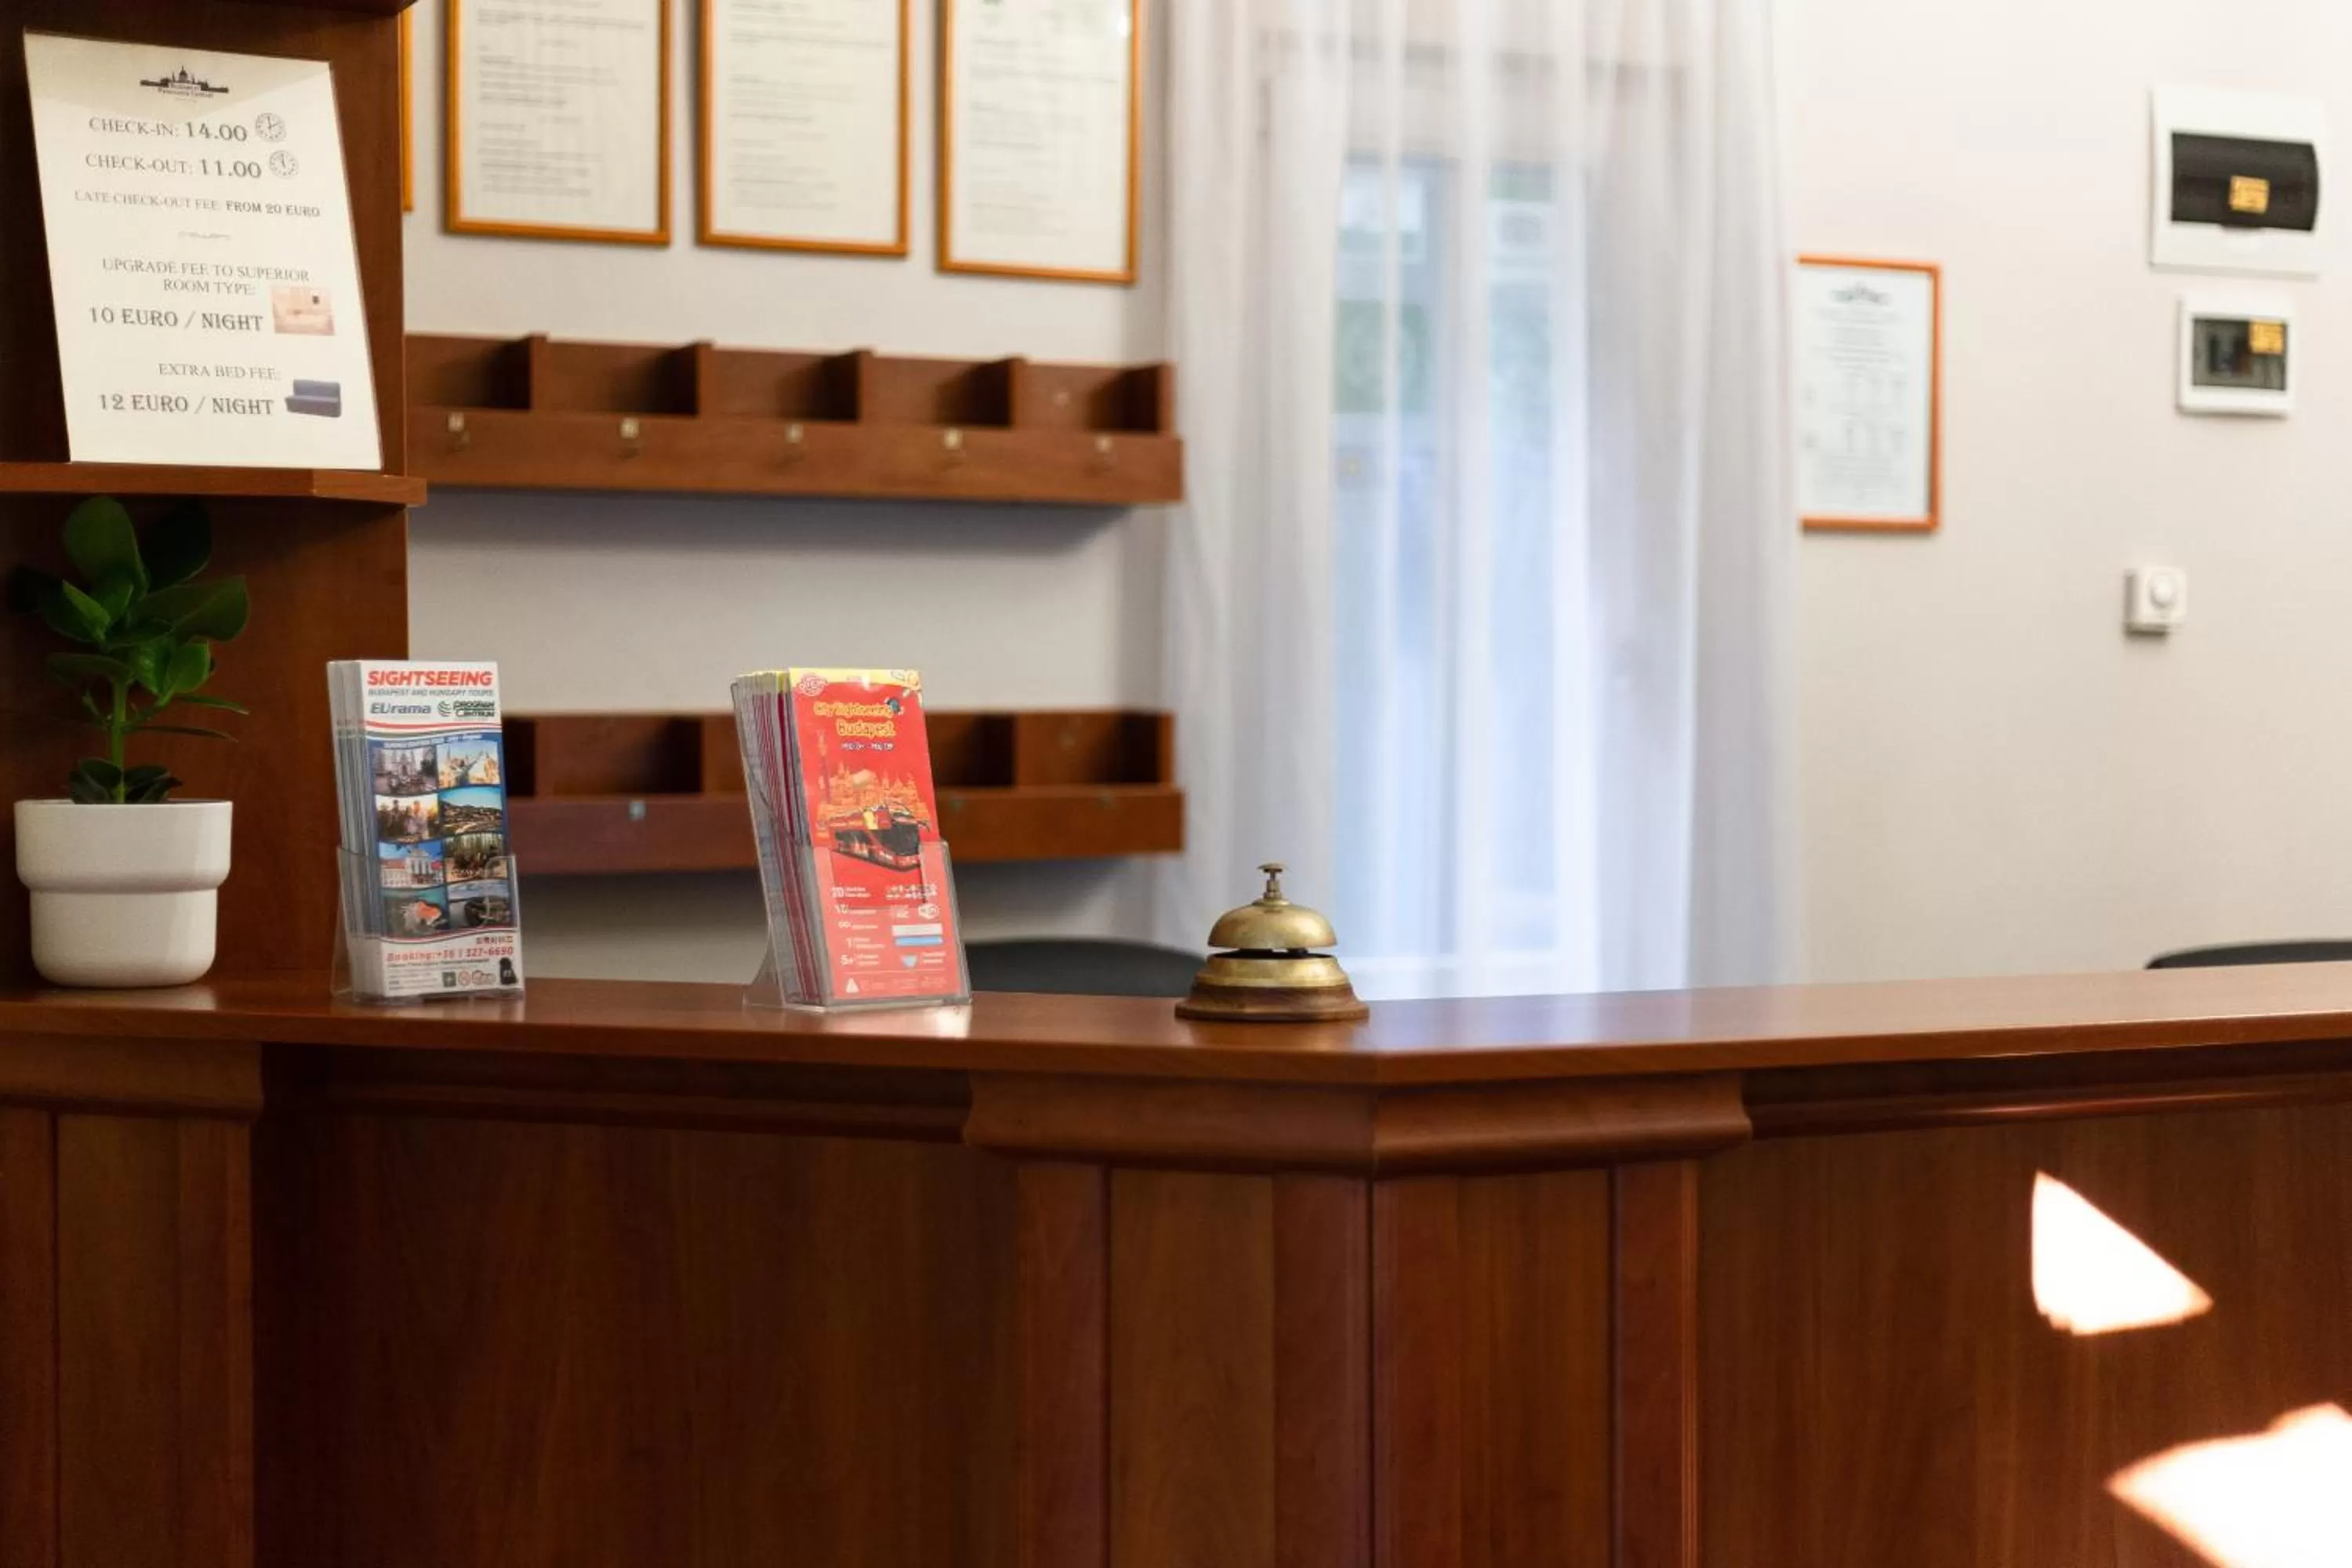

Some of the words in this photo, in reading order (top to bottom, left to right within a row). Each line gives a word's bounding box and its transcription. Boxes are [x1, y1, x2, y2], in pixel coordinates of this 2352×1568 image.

[89, 118, 179, 137] CHECK-IN:
[187, 122, 248, 142] 14.00
[85, 153, 194, 176] CHECK-OUT:
[201, 158, 262, 179] 11.00
[74, 191, 111, 203] LATE
[112, 194, 191, 209] CHECK-OUT
[226, 200, 262, 213] FROM
[265, 203, 282, 214] 20
[285, 205, 321, 217] EURO
[103, 257, 178, 274] UPGRADE
[181, 263, 209, 275] FEE
[212, 264, 234, 278] TO
[236, 266, 310, 281] SUPERIOR
[163, 278, 210, 293] ROOM
[212, 281, 256, 296] TYPE:
[90, 307, 115, 324] 10
[122, 308, 179, 328] EURO
[183, 310, 197, 329] /
[201, 313, 264, 332] NIGHT
[158, 362, 211, 377] EXTRA
[215, 364, 246, 378] BED
[249, 366, 281, 381] FEE:
[99, 394, 125, 411] 12
[132, 394, 190, 413] EURO
[193, 396, 206, 415] /
[212, 397, 274, 416] NIGHT
[367, 670, 494, 687] SIGHTSEEING
[836, 718, 897, 739] Budapest
